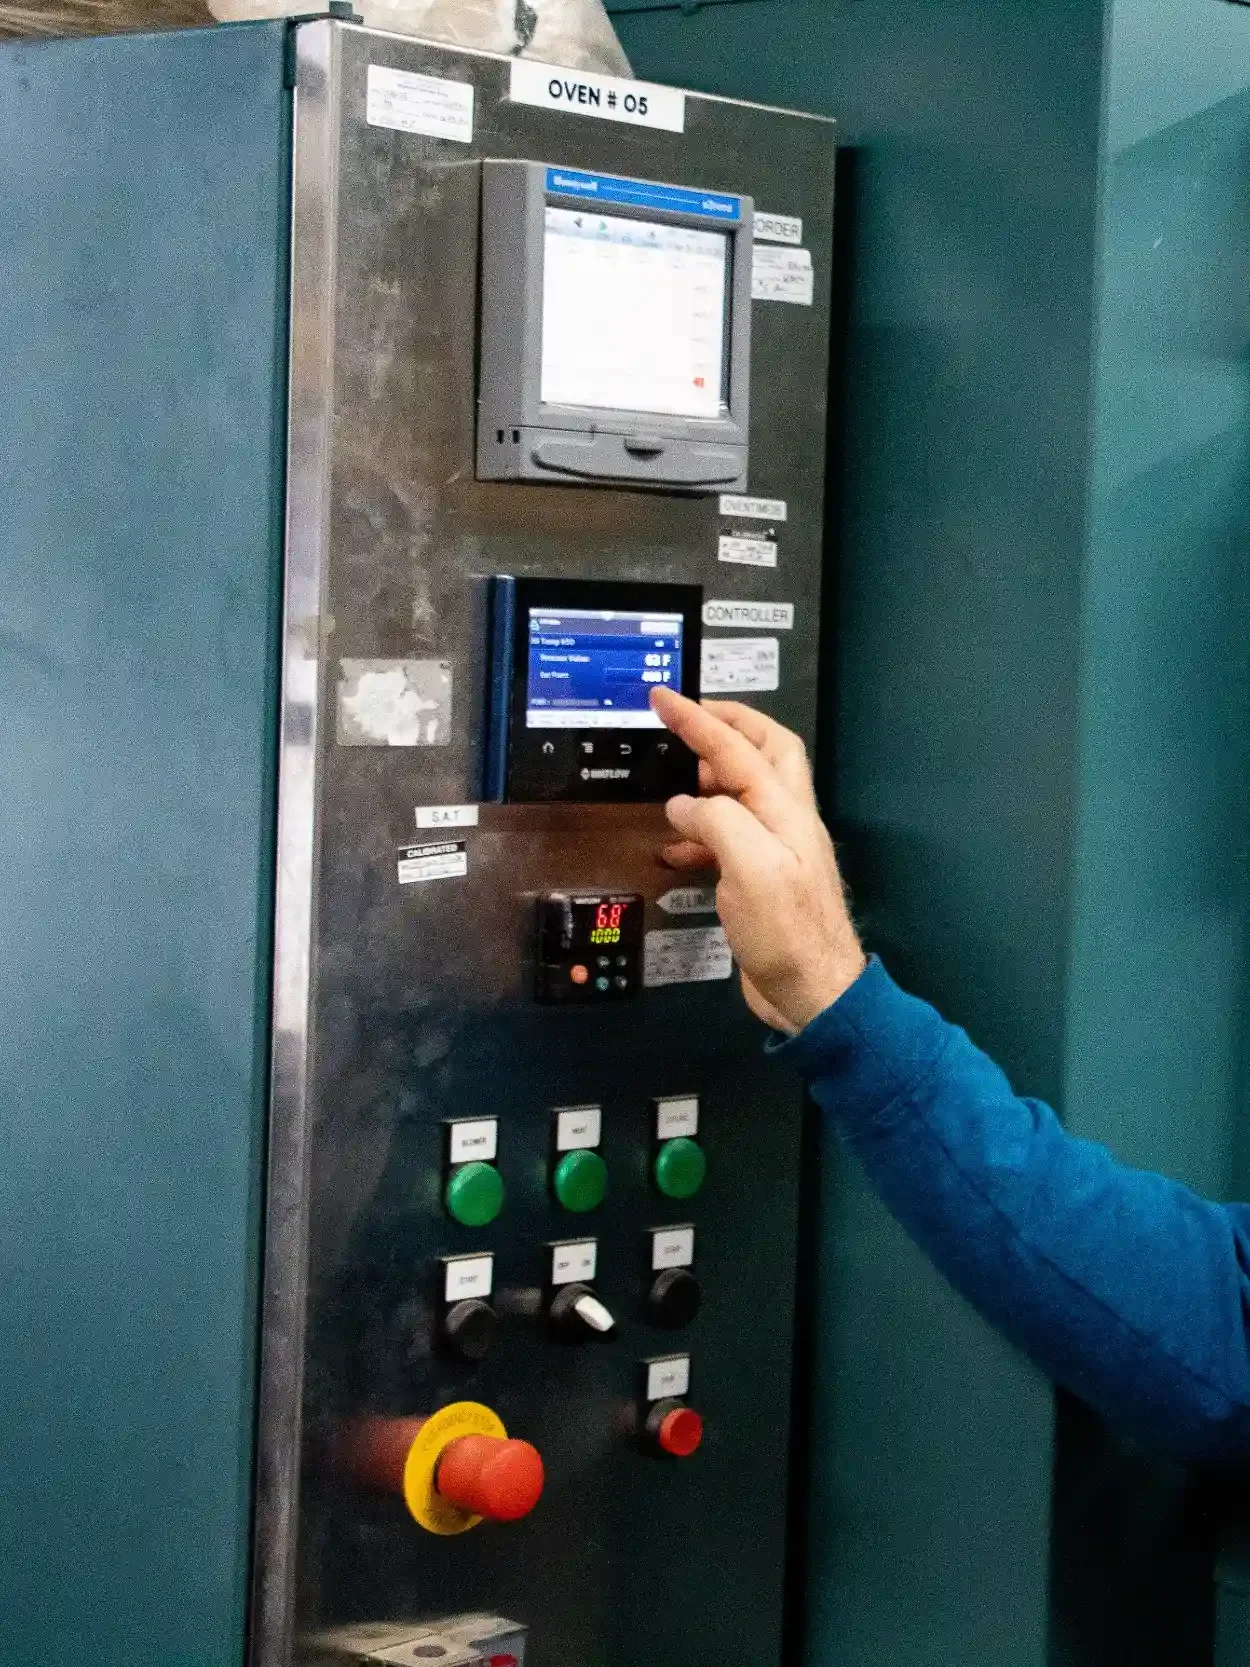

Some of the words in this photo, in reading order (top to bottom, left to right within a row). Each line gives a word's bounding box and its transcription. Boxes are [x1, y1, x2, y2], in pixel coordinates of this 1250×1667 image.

[548, 79, 600, 107] OVEN
[607, 90, 617, 110] #
[755, 218, 800, 238] ORDER
[706, 606, 788, 623] CONTROLLER
